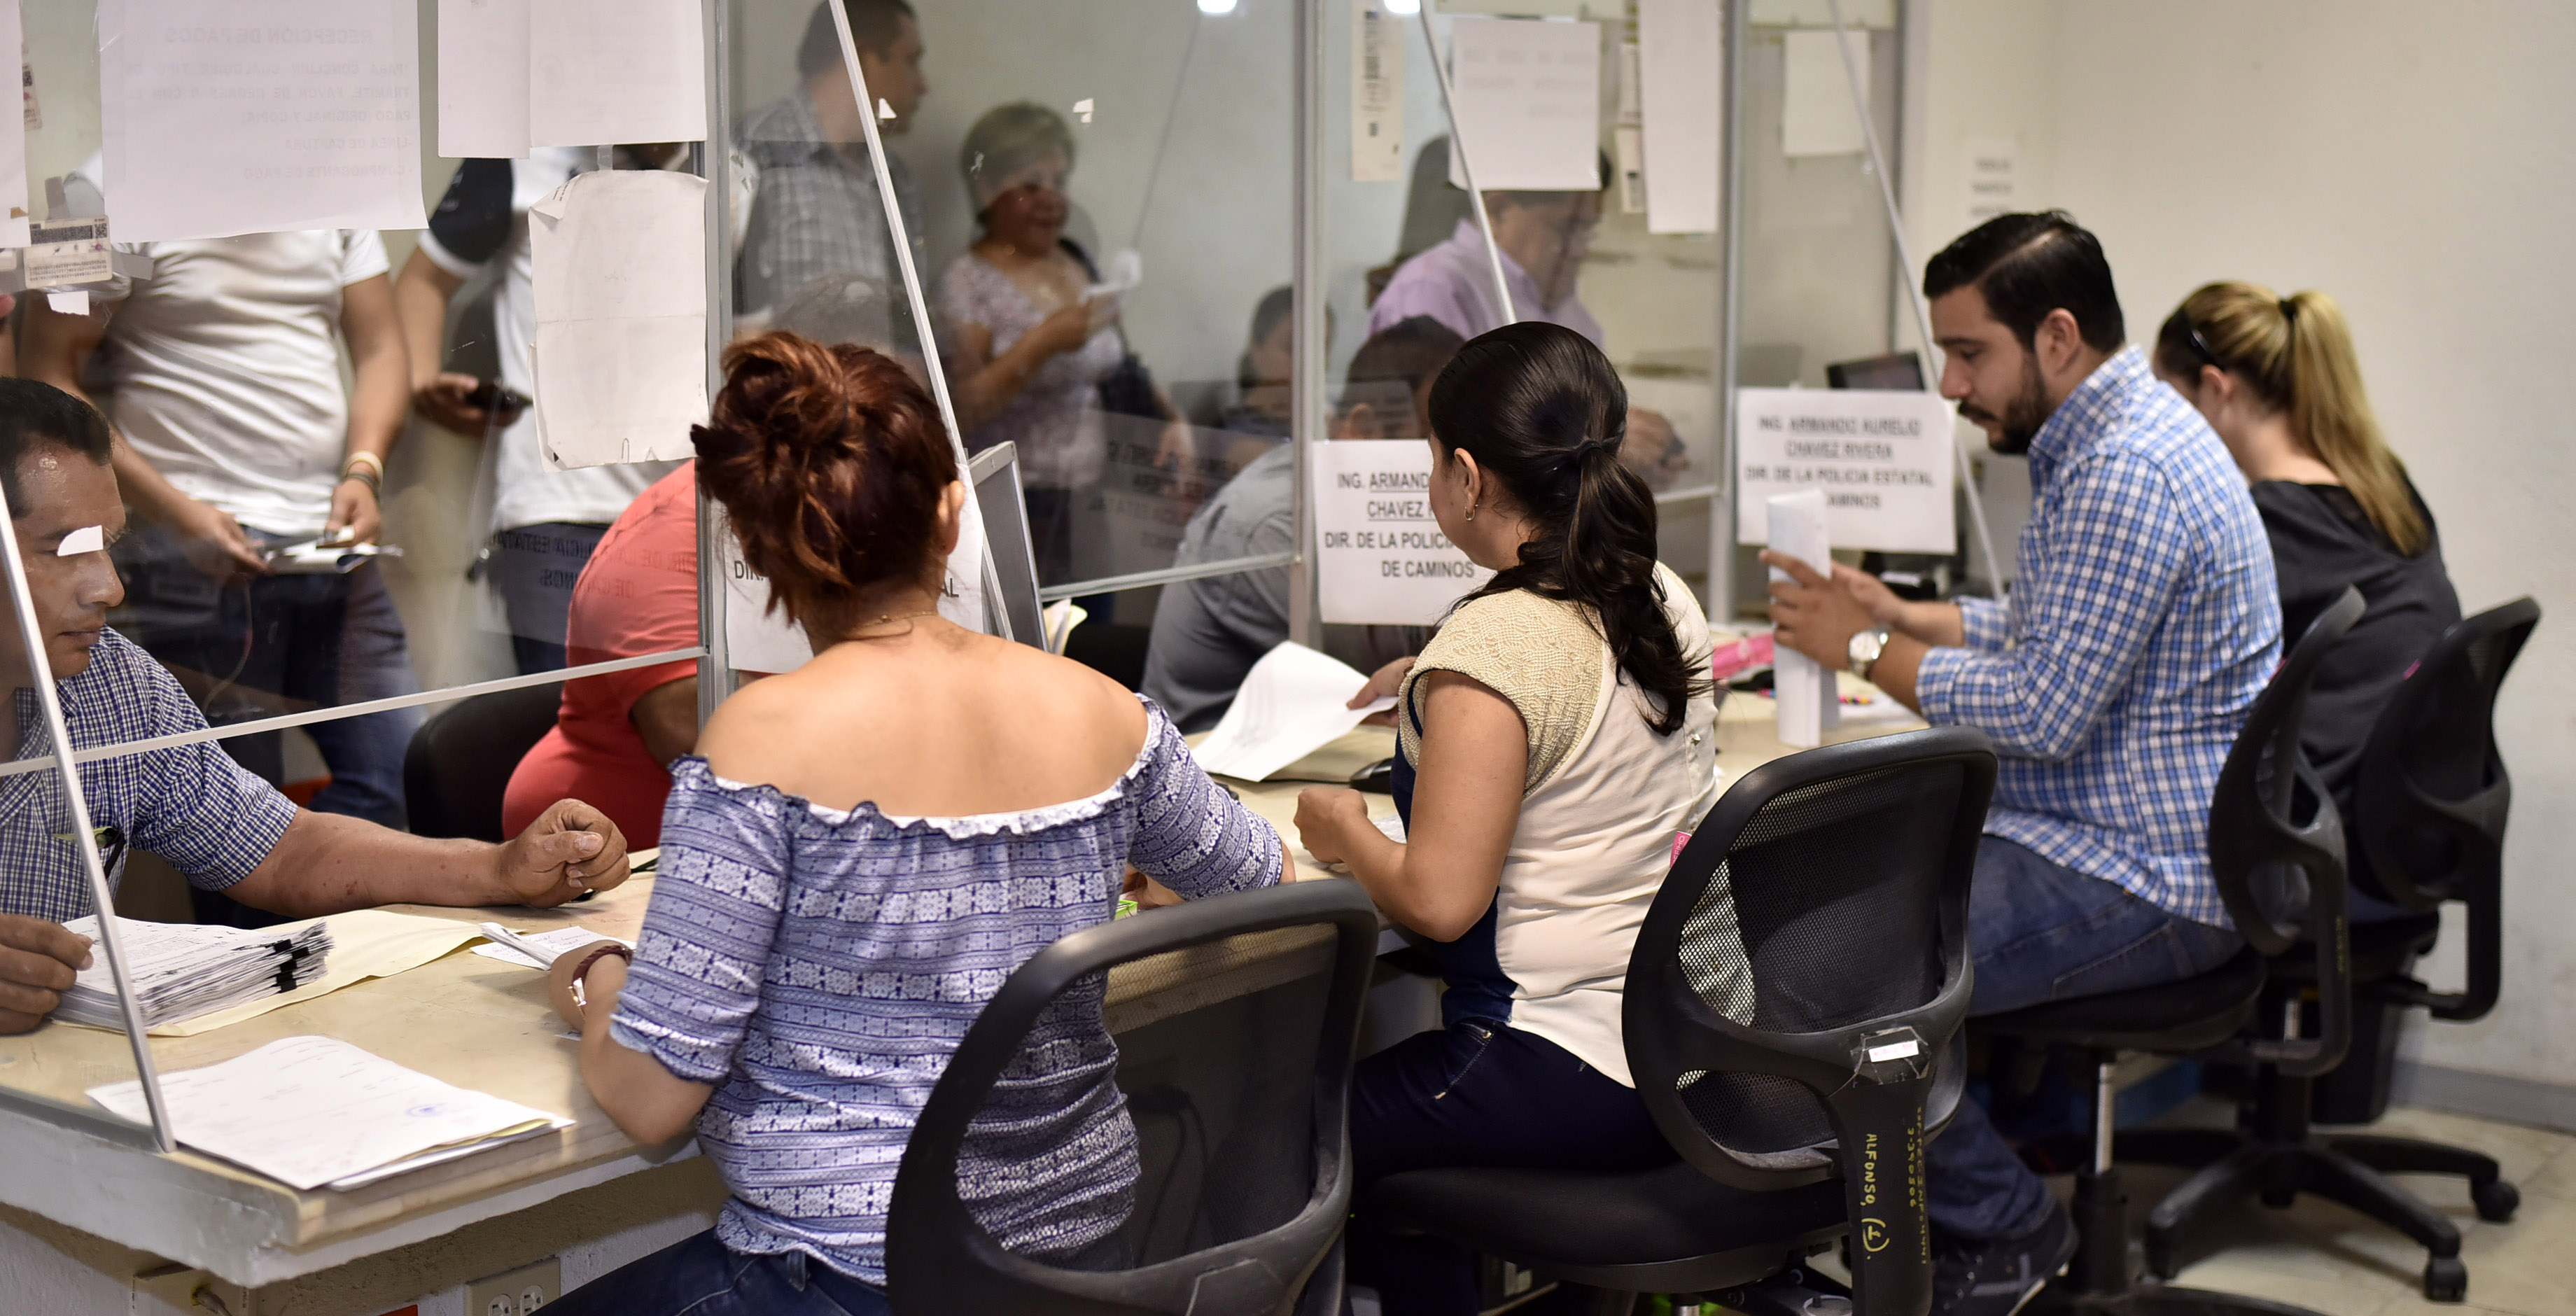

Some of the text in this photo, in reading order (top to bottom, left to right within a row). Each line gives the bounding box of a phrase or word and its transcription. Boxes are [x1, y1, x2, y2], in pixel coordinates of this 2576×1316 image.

[1338, 472, 1429, 489] ING. ARMAND
[1774, 465, 1791, 483] DE
[1795, 467, 1812, 484] LA
[1368, 501, 1424, 517] CHAVEZ
[1826, 493, 1881, 510] AMINOS
[1325, 533, 1352, 548] DIR.
[1357, 533, 1375, 548] DE
[1379, 533, 1397, 548] LA
[1382, 561, 1474, 578] DE CAMINOS
